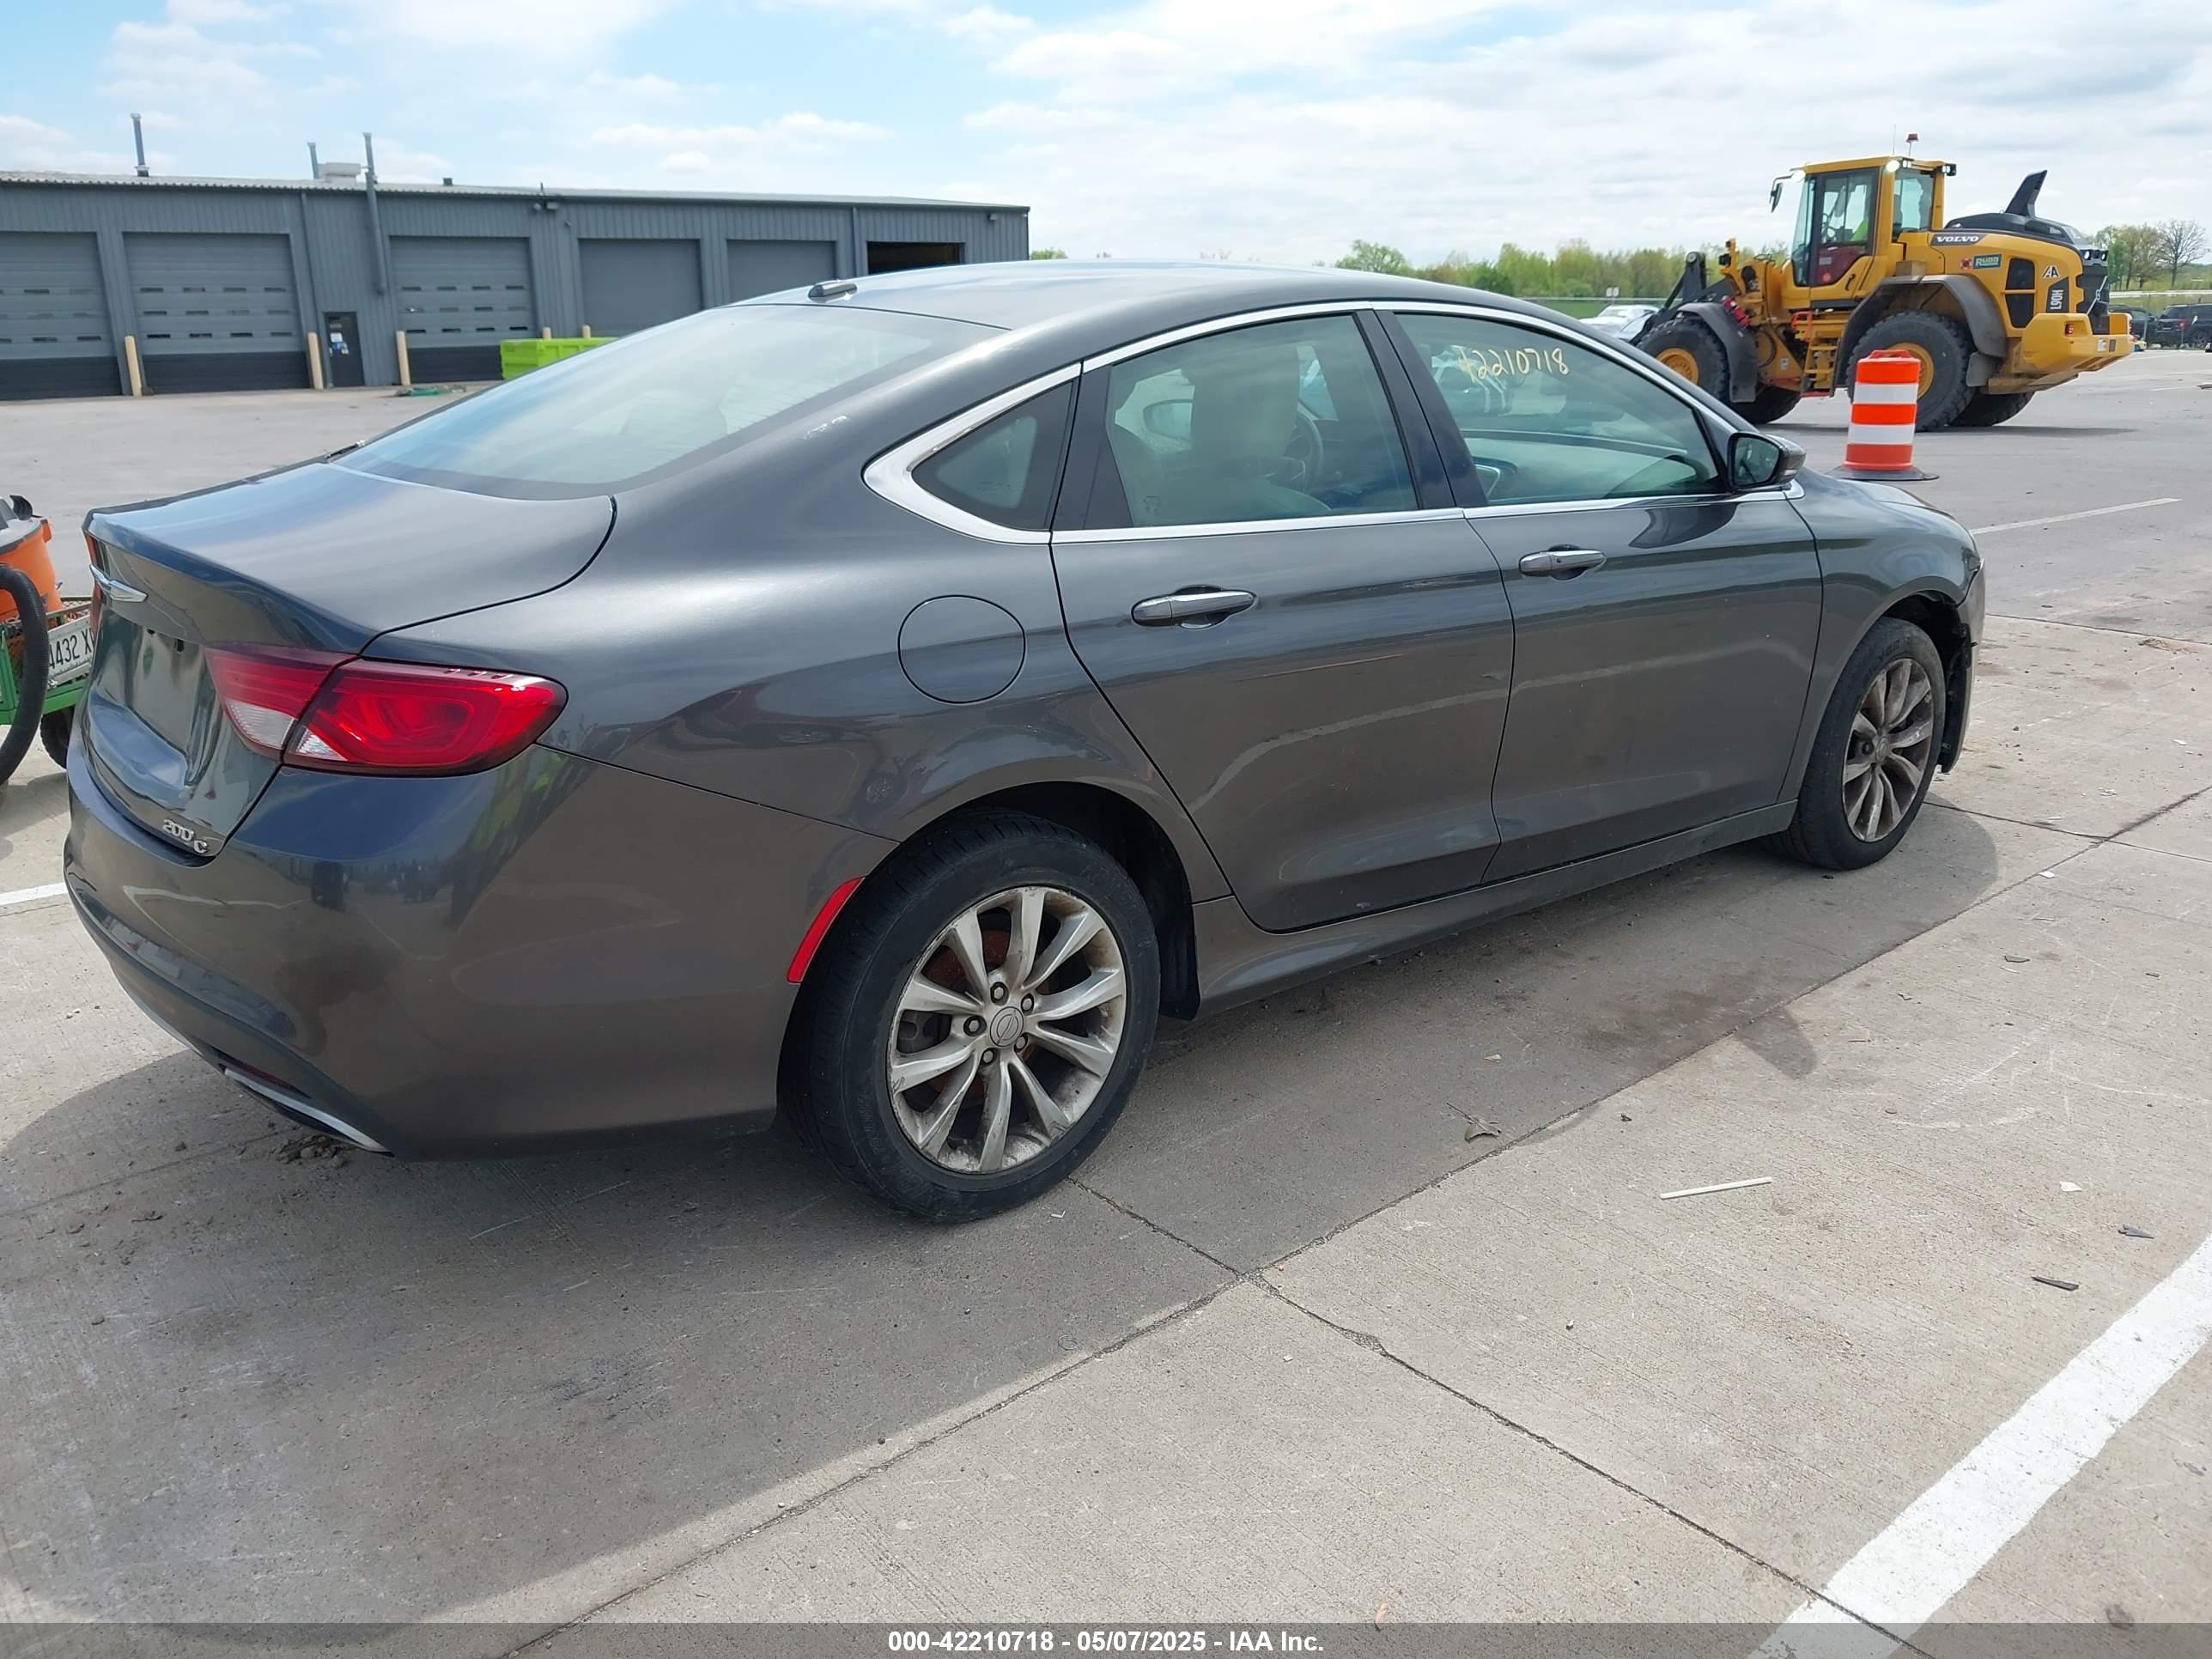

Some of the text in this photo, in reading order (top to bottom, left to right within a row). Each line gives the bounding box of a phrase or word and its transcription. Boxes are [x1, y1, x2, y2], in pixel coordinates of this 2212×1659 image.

[2050, 289, 2064, 310] L90H
[163, 819, 208, 854] 200 C
